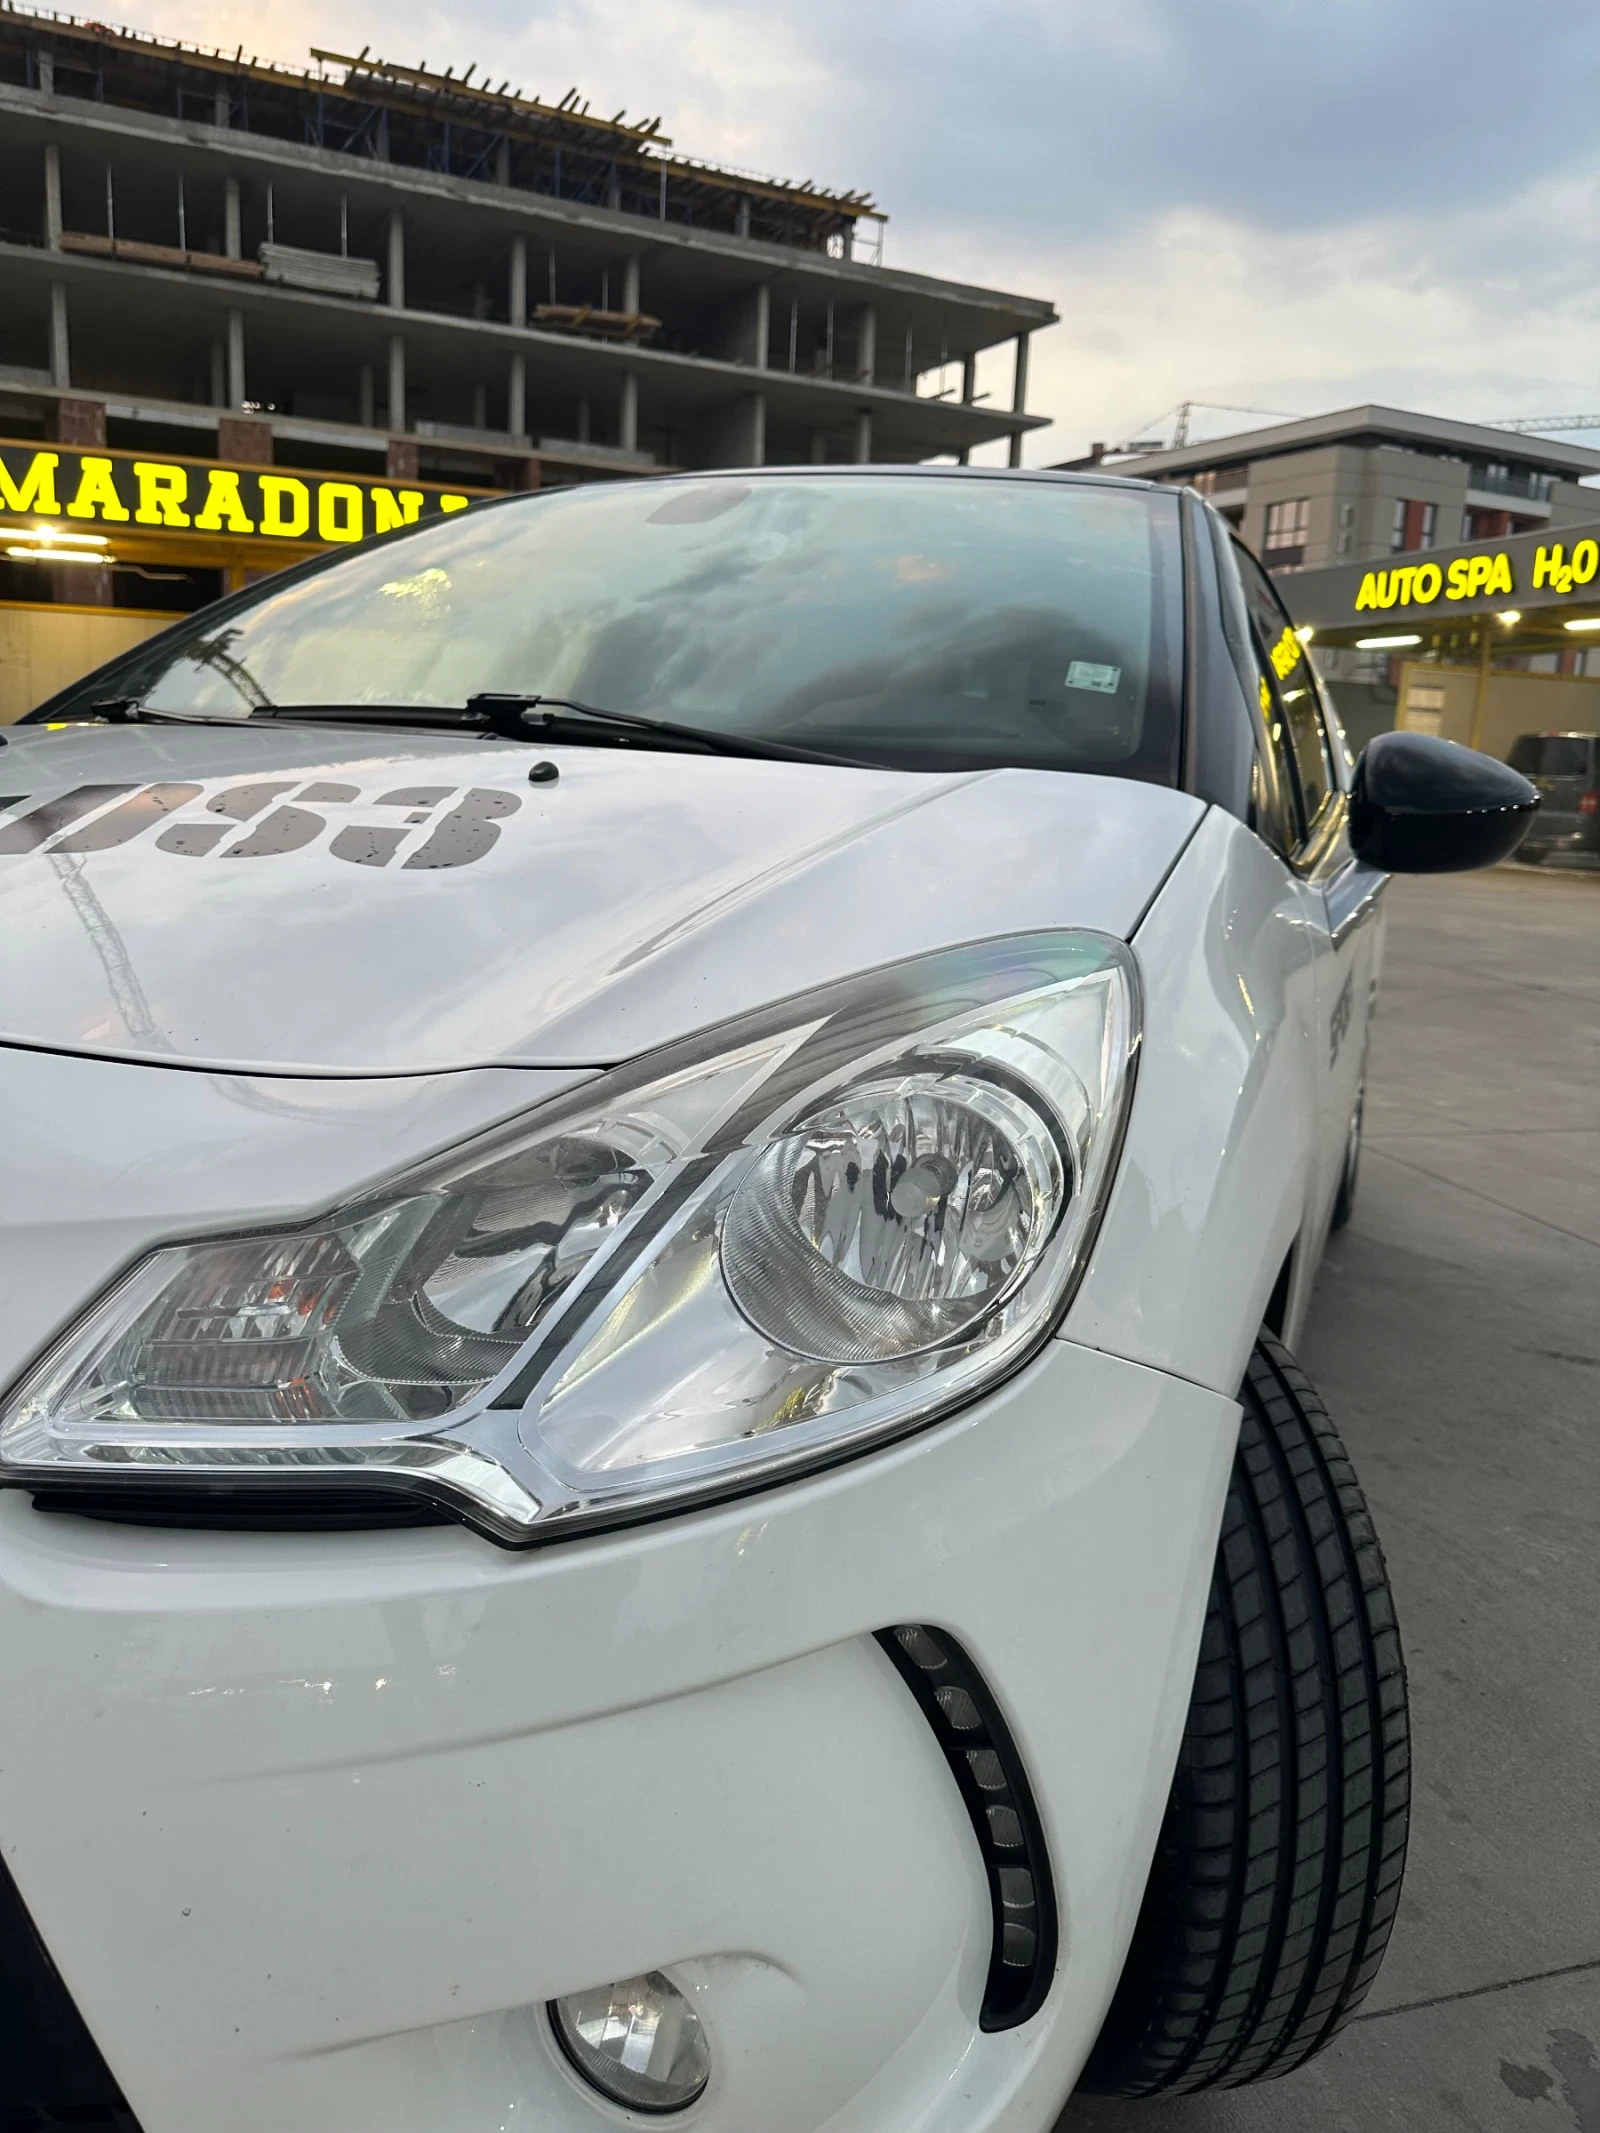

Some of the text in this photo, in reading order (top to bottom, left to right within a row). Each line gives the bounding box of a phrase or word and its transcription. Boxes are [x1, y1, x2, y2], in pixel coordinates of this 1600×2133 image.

[0, 452, 469, 543] MARADON
[1355, 563, 1442, 611] AUTO
[1445, 553, 1512, 600] SPA
